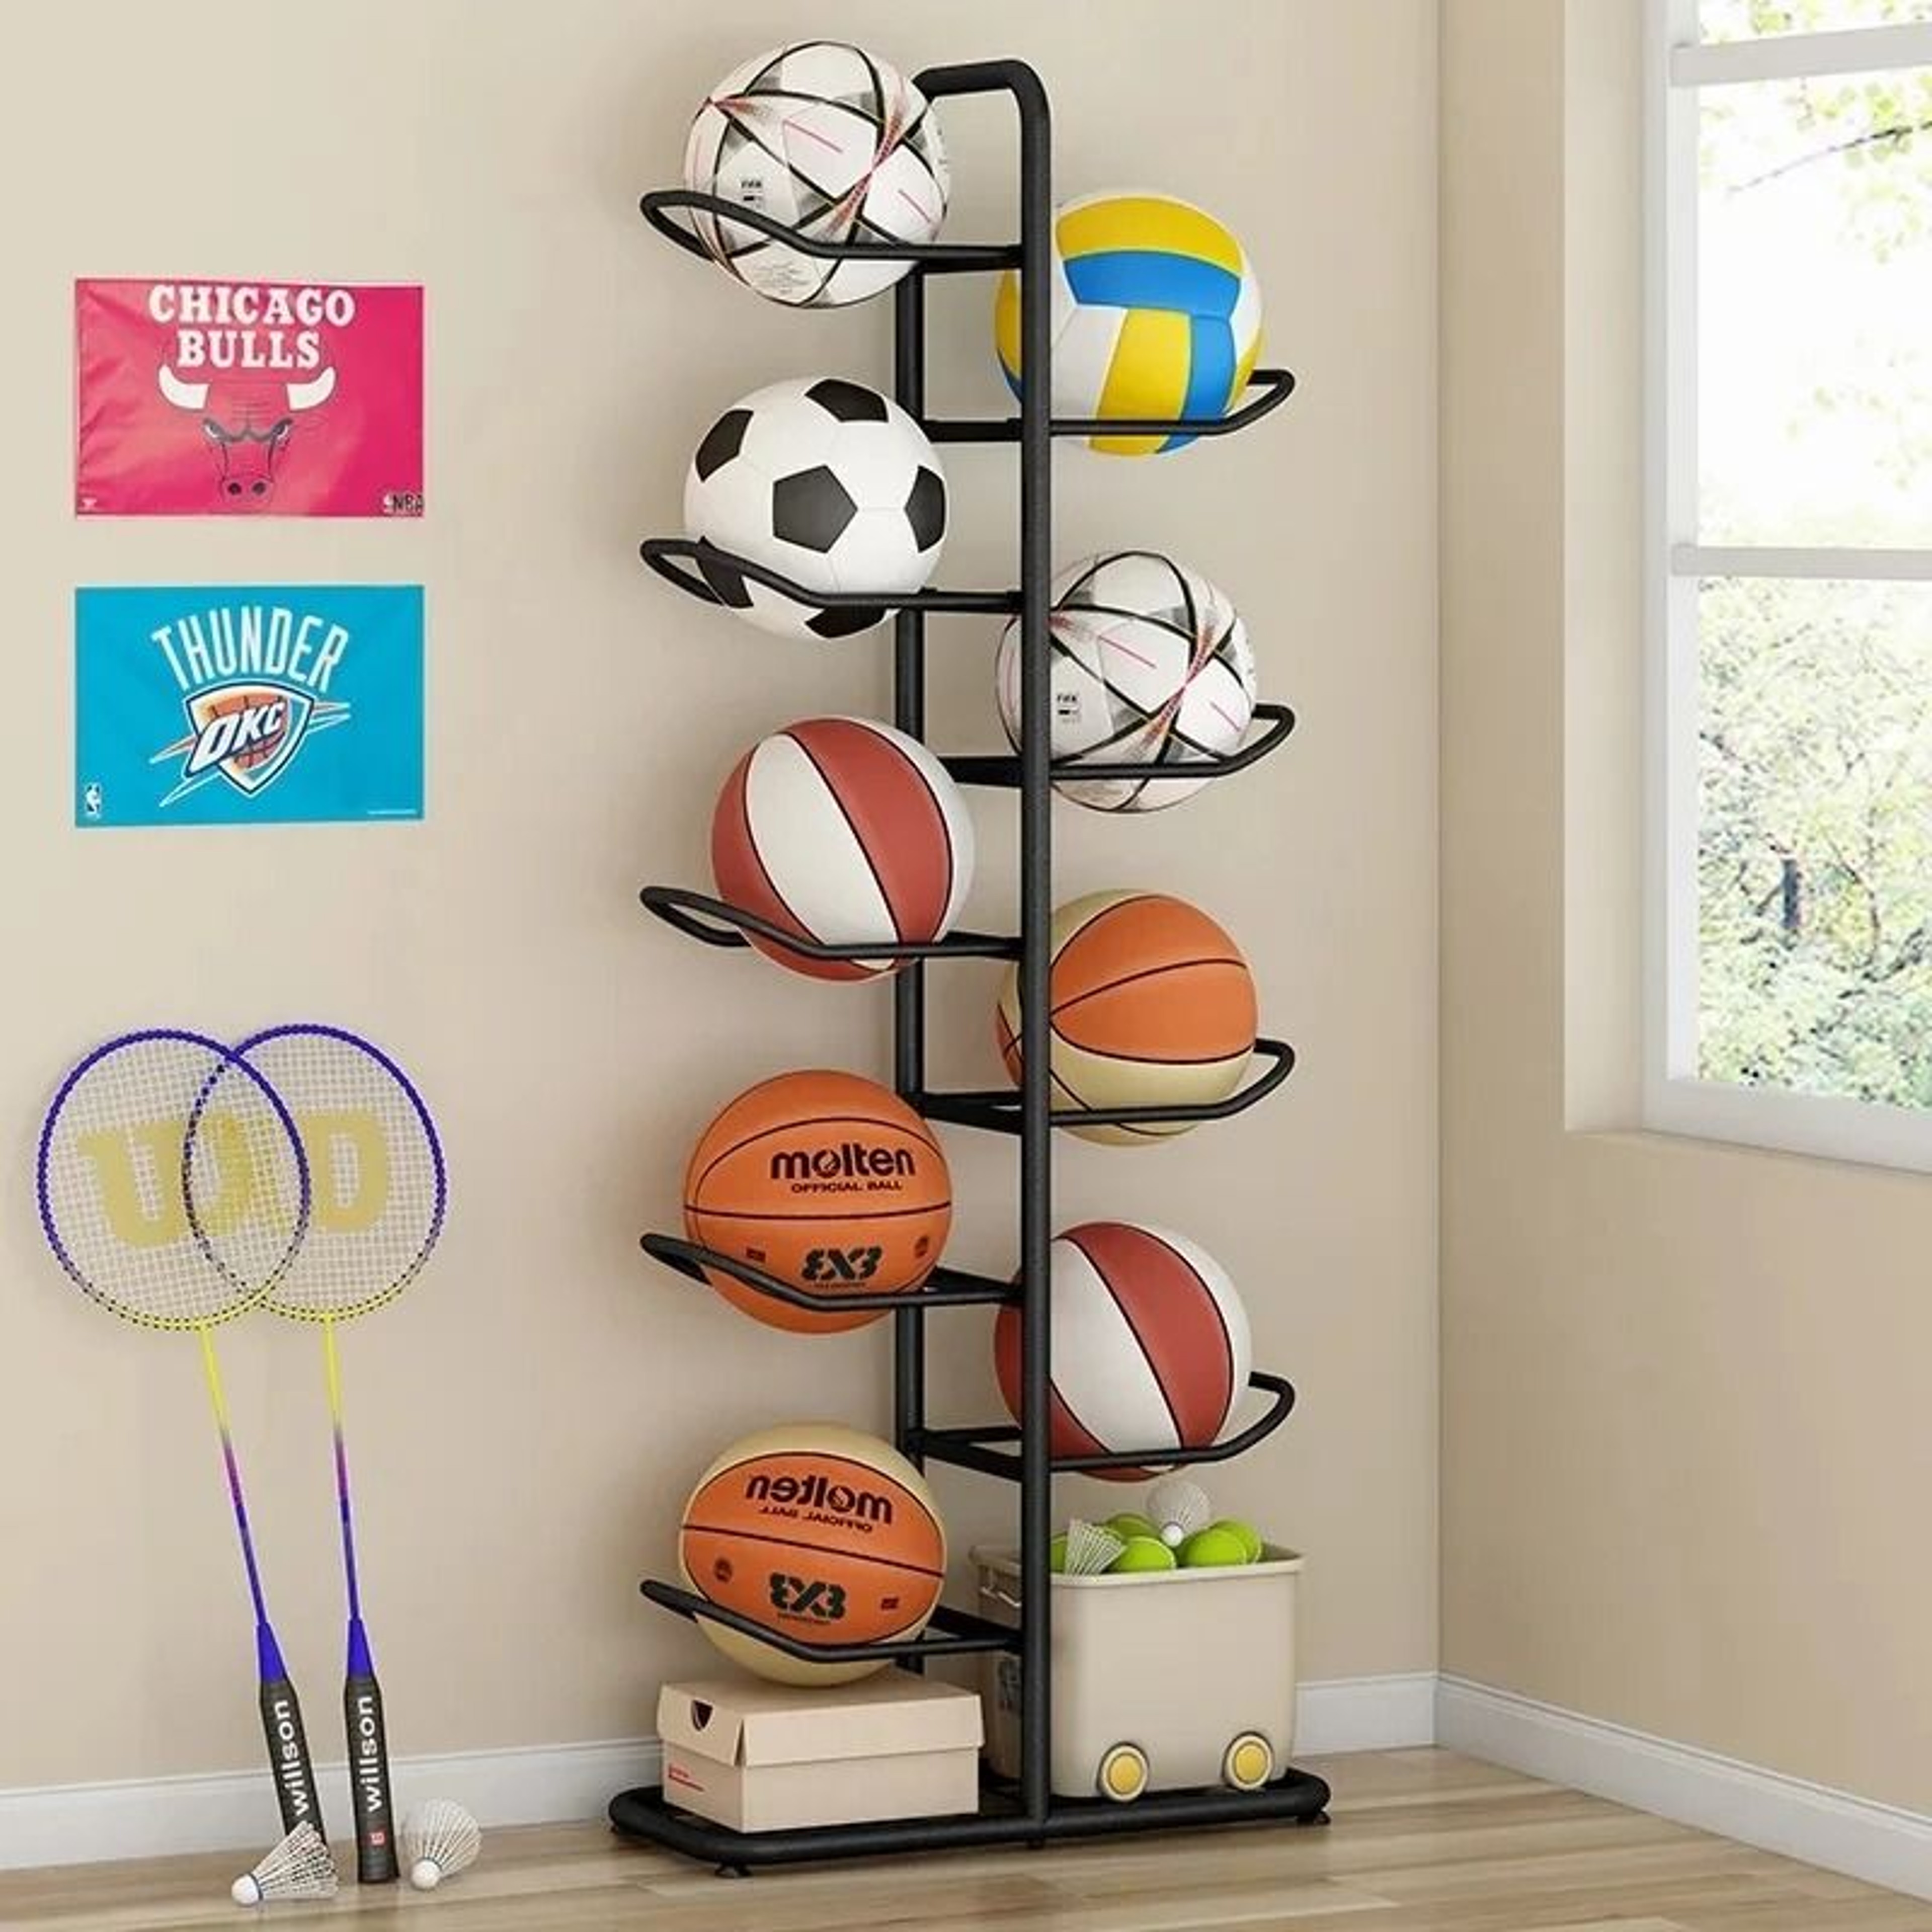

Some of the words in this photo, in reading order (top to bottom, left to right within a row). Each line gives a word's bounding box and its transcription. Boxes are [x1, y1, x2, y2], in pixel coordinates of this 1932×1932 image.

[149, 284, 355, 327] CHICAGO
[177, 329, 320, 368] BULLS
[151, 606, 349, 693] THUNDER
[188, 702, 286, 773] OKC
[771, 1144, 916, 1179] molten
[791, 1182, 862, 1193] OFFICIAL
[867, 1180, 903, 1191] BALL
[275, 1700, 309, 1816] willson
[358, 1696, 382, 1812] willson
